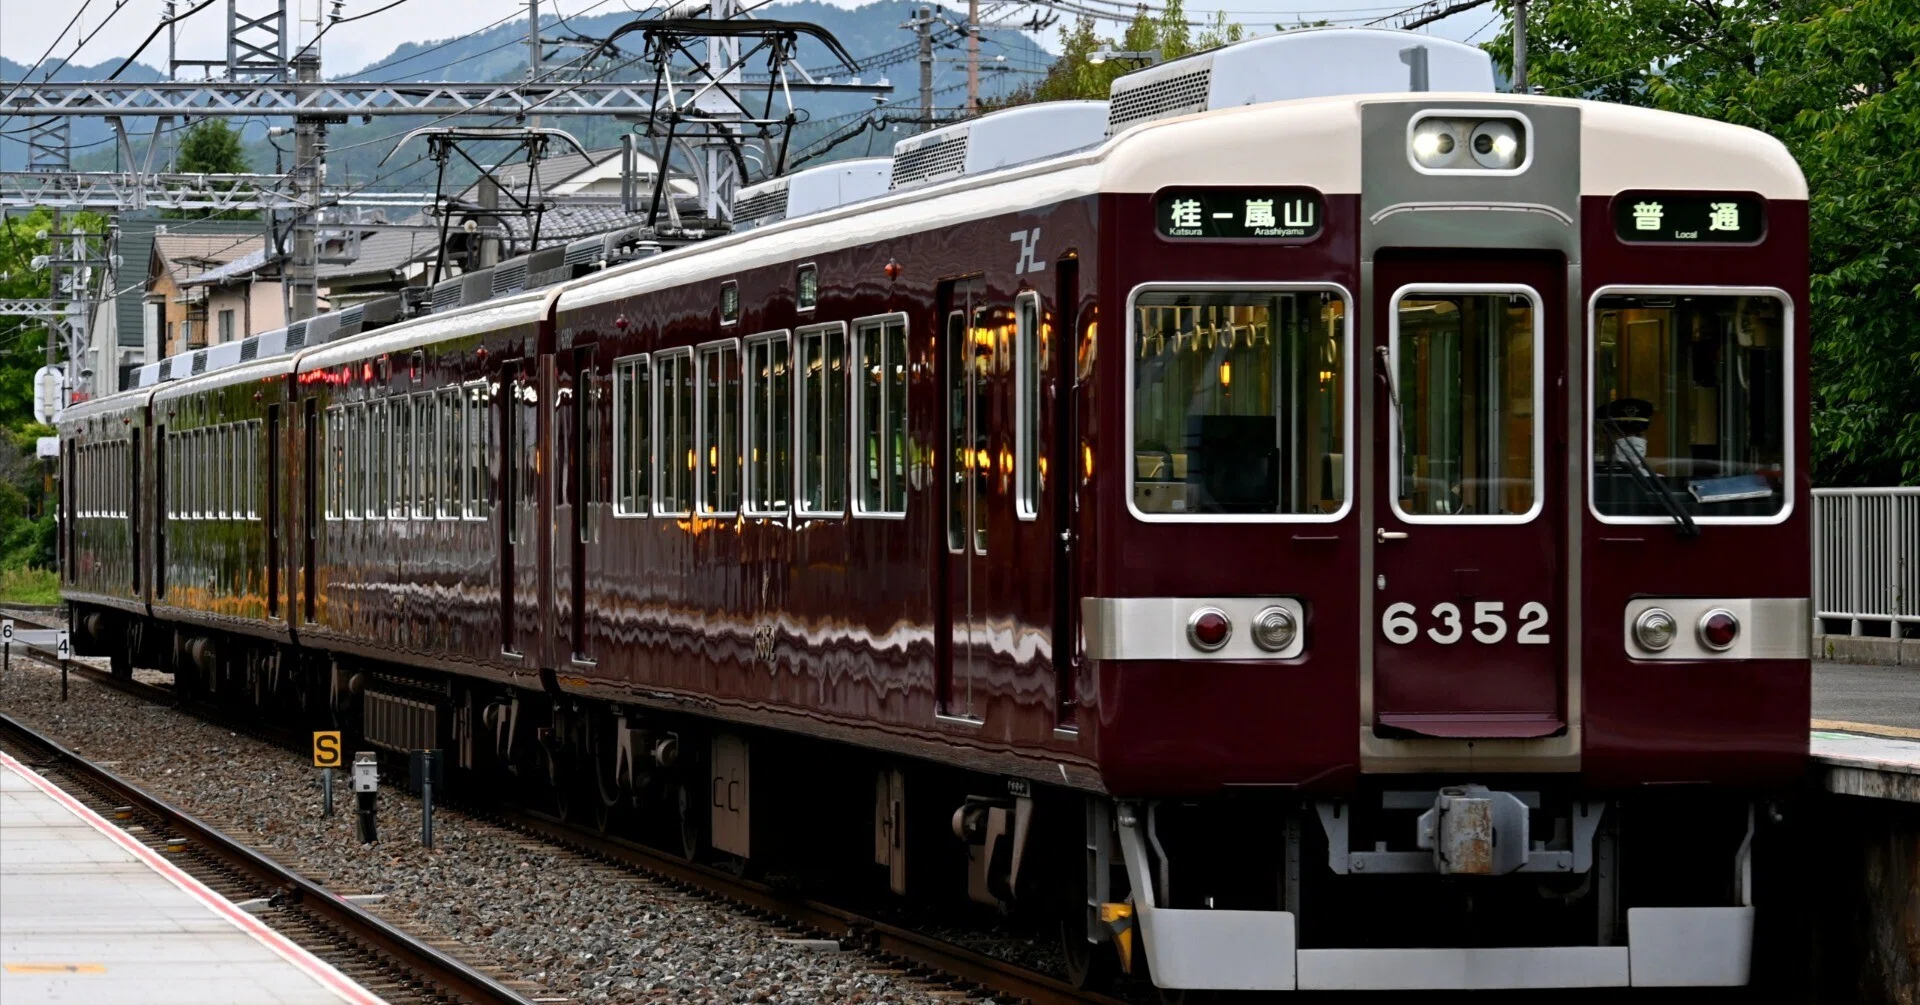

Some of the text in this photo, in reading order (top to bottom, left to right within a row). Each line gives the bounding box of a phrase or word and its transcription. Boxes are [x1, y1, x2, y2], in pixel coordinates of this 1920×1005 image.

[1632, 201, 1740, 231] 普通
[1169, 227, 1305, 237] Katsura Arashiyama
[1675, 230, 1698, 239] Local
[3, 624, 13, 638] 6
[1382, 601, 1550, 645] 6352
[58, 638, 69, 654] 4
[316, 735, 339, 764] S
